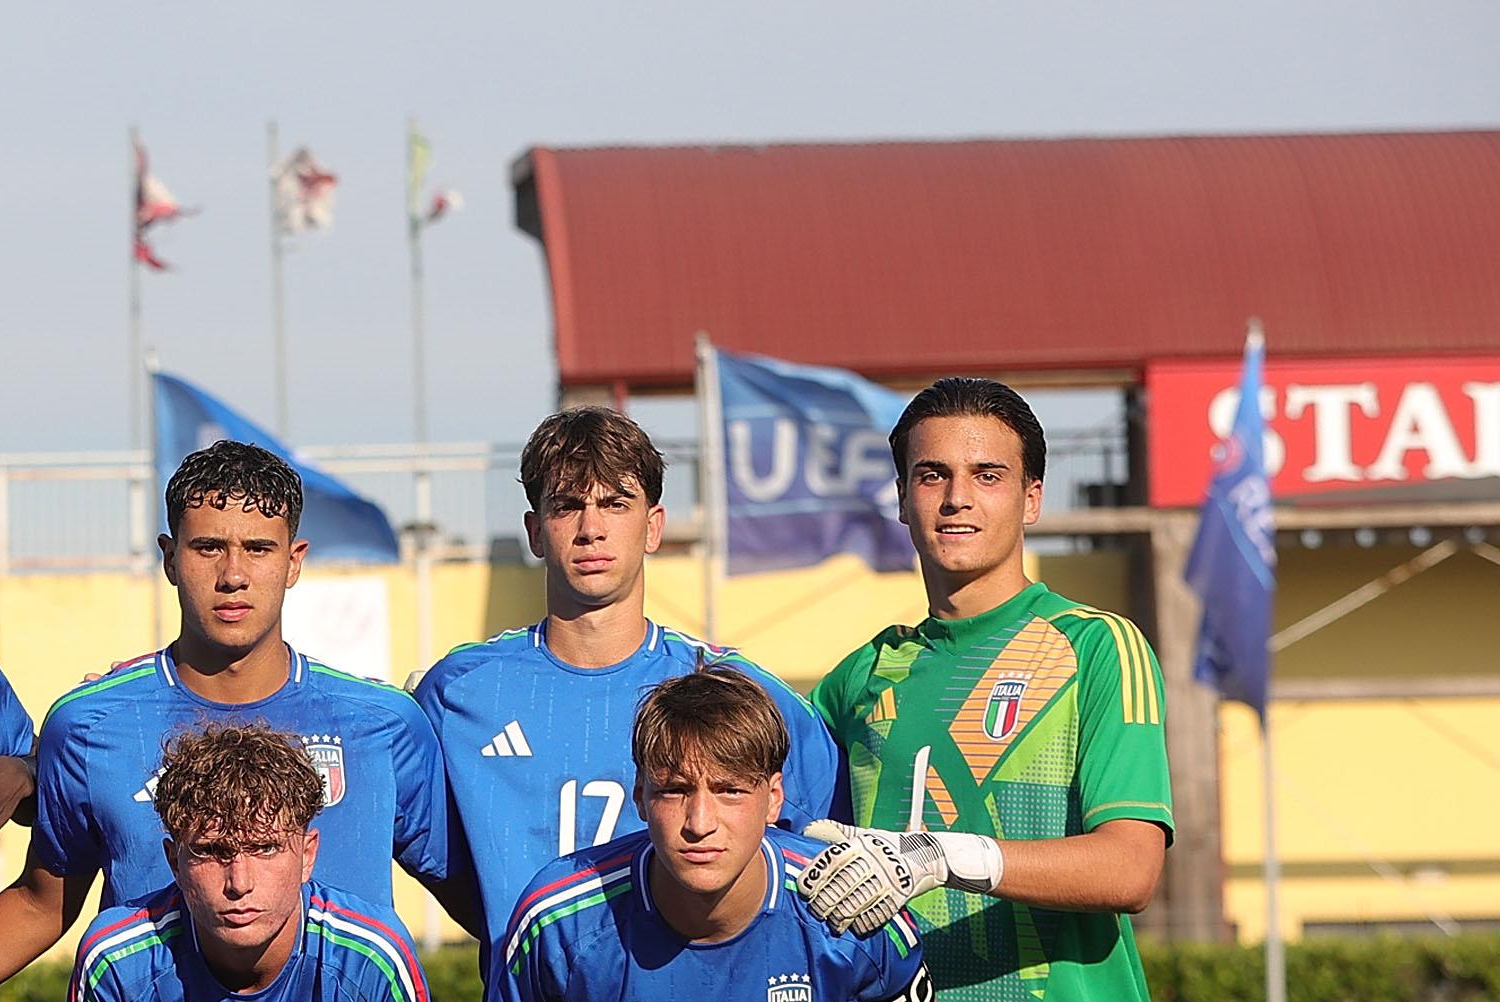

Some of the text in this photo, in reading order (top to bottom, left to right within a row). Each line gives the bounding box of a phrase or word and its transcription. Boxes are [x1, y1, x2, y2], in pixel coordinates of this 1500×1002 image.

[994, 684, 1023, 696] ITALIA
[558, 780, 625, 857] 17
[803, 841, 851, 890] reusch
[863, 833, 911, 889] reusch
